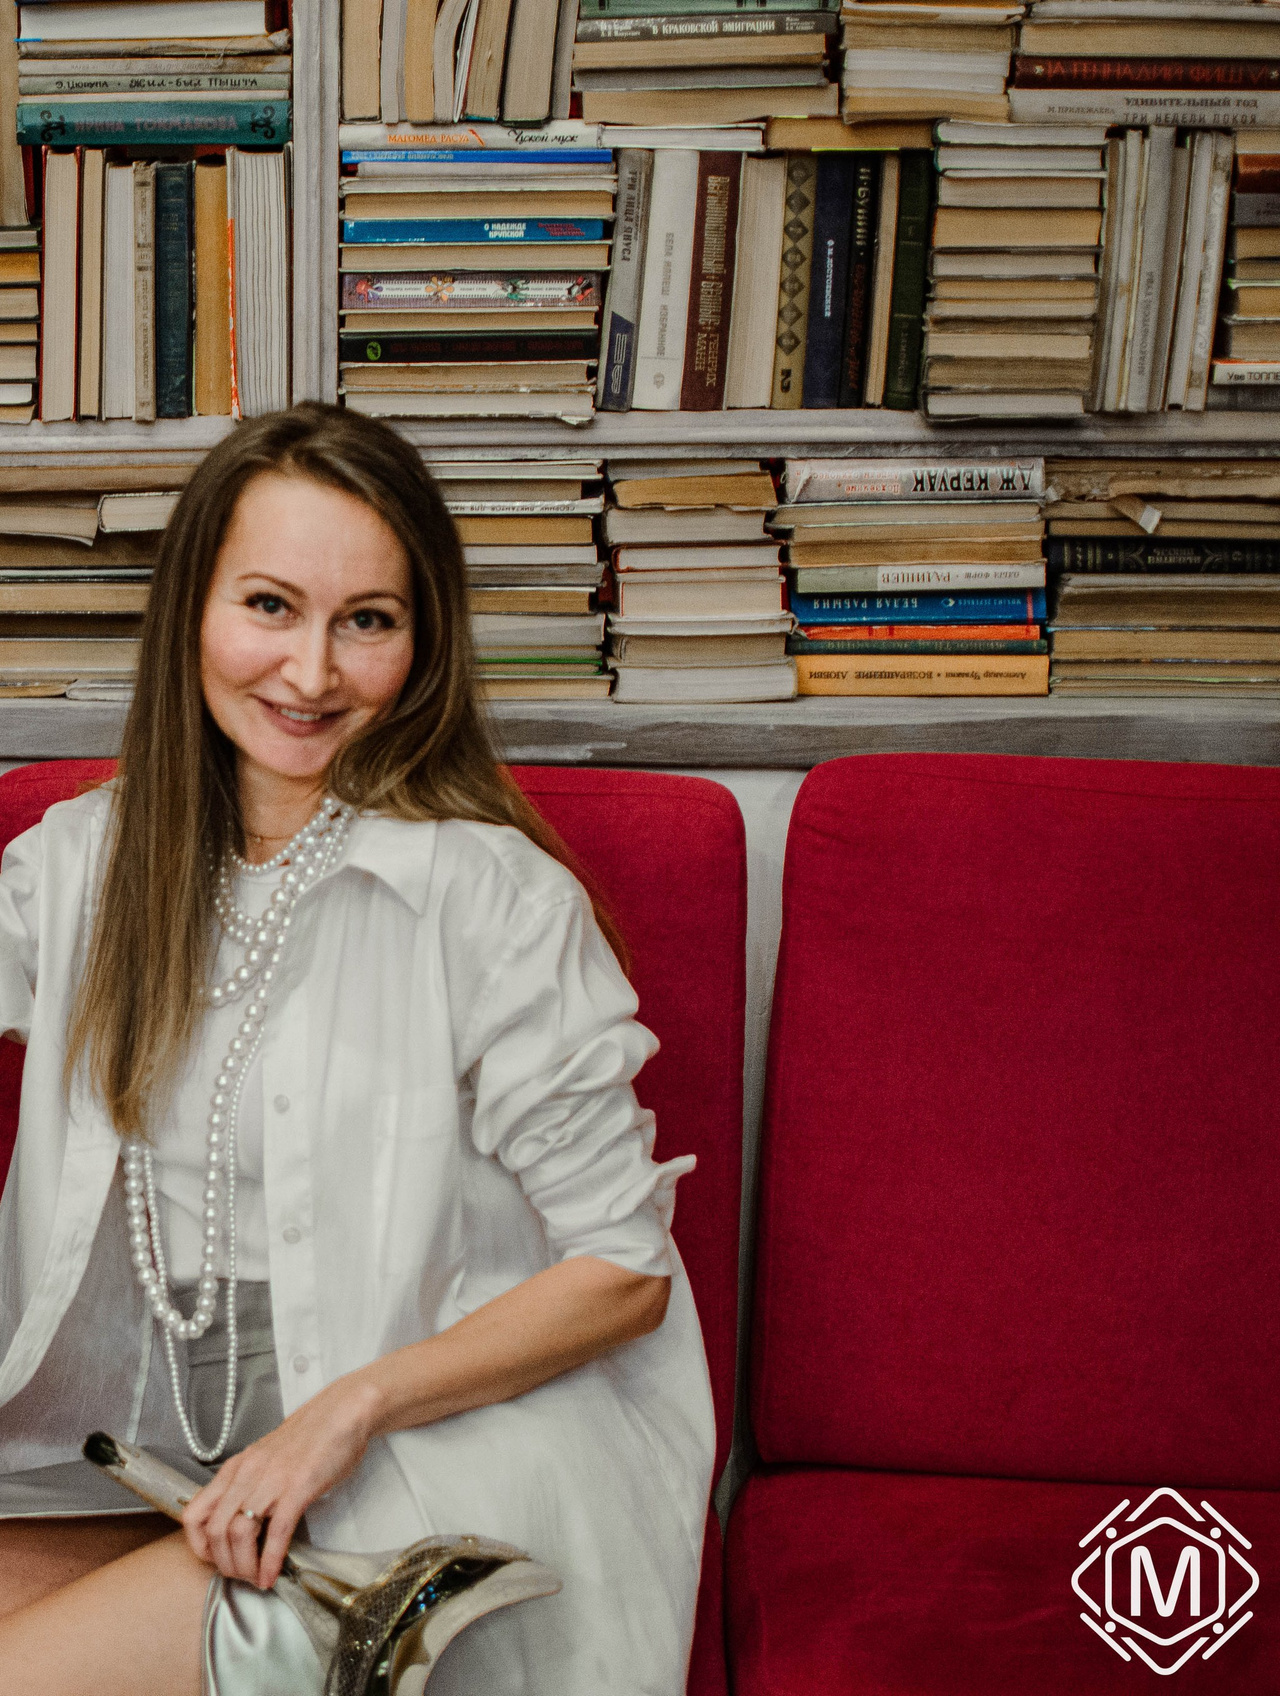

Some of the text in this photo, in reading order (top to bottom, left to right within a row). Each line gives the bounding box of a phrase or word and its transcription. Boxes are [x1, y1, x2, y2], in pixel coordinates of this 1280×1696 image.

[652, 24, 658, 34] В
[662, 21, 718, 35] КРАКОВСКОЙ
[722, 20, 775, 33] ЭМИГРАЦИИ
[1125, 96, 1258, 108] УДИВИТЕЛЬНЫЙ ГОД
[75, 115, 239, 132] ИРИНА ТОКМАКОВА
[1124, 113, 1257, 123] ТРИ НЕДЕЛИ ПОКОЯ
[387, 134, 470, 144] МАГОМЕД РАСУЛ
[551, 134, 579, 145] муж
[628, 169, 638, 190] ТРИ
[624, 193, 636, 223] ЛИЦА
[483, 222, 527, 231] О НАДЕЖДЕ
[488, 231, 524, 239] КРУПСКОЙ
[621, 226, 634, 262] ЯНУСА
[656, 304, 668, 357] ИЗБРАННОЕ
[695, 332, 707, 371] МАНН
[705, 333, 720, 387] ГЕНРИХ
[1227, 371, 1245, 381] Уве
[912, 468, 989, 492] КЕРУАК
[881, 571, 951, 584] РАДИЩЕВ
[813, 598, 918, 610] БЕЛАЯ РАБЫНЯ
[809, 670, 934, 681] ВОЗВРАЩЕНИЕ ЛЮБВИ
[983, 671, 1027, 680] Александр
